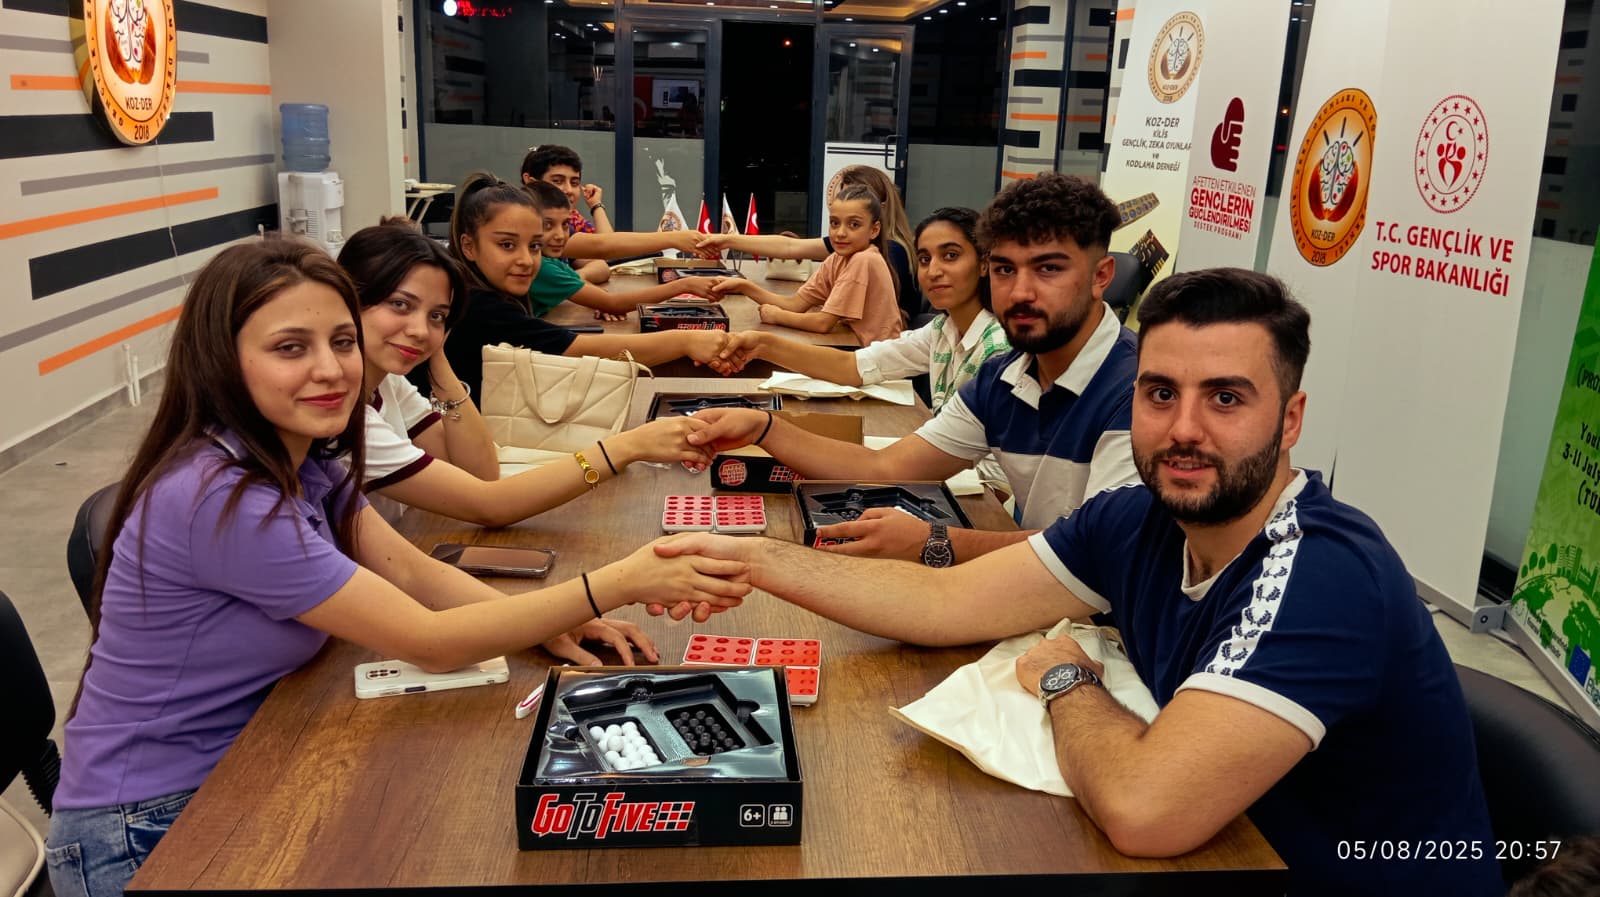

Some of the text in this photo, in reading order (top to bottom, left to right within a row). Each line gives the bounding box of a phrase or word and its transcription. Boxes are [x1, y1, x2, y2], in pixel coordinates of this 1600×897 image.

[125, 96, 153, 110] KOZ-DER
[1145, 117, 1180, 128] KOZ-DER
[134, 124, 150, 140] 2018
[1149, 140, 1164, 149] ZEKA
[1126, 160, 1155, 169] KODLAMA
[1311, 229, 1336, 242] KOZ-DER
[1376, 221, 1514, 263] T.C. GENÇLİK VE
[1371, 250, 1509, 297] SPOR BAKANLIĞI
[743, 808, 761, 821] 6+
